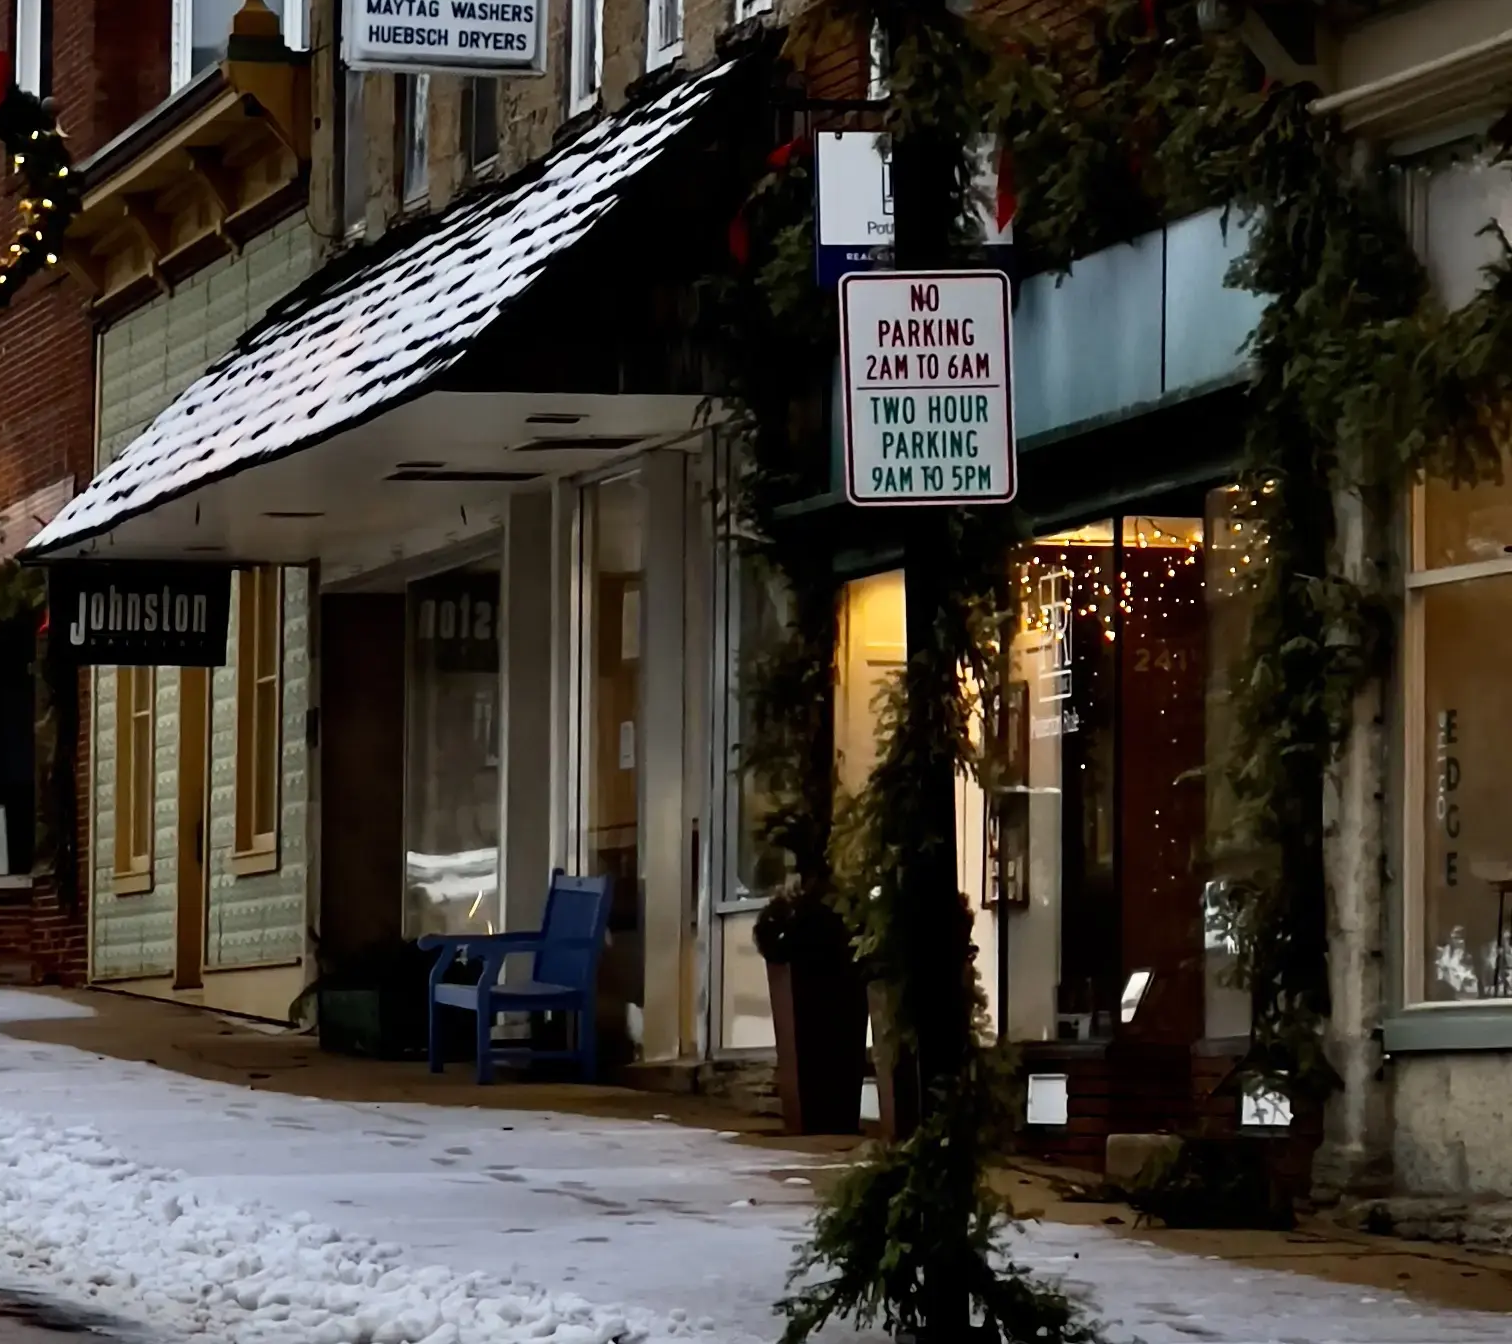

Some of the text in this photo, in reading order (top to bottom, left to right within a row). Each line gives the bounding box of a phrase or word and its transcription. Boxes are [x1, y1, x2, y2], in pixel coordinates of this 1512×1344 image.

[451, 0, 535, 23] WASHERS
[368, 24, 528, 52] HUEBSCH DRYERS
[910, 283, 940, 313] NO
[877, 318, 975, 348] PARKING
[866, 352, 990, 381] 2AM TO 6AM
[870, 394, 989, 425] TWO HOUR
[881, 430, 979, 460] PARKING
[871, 464, 992, 493] 9AM TO 5PM
[1446, 709, 1461, 887] EDGE
